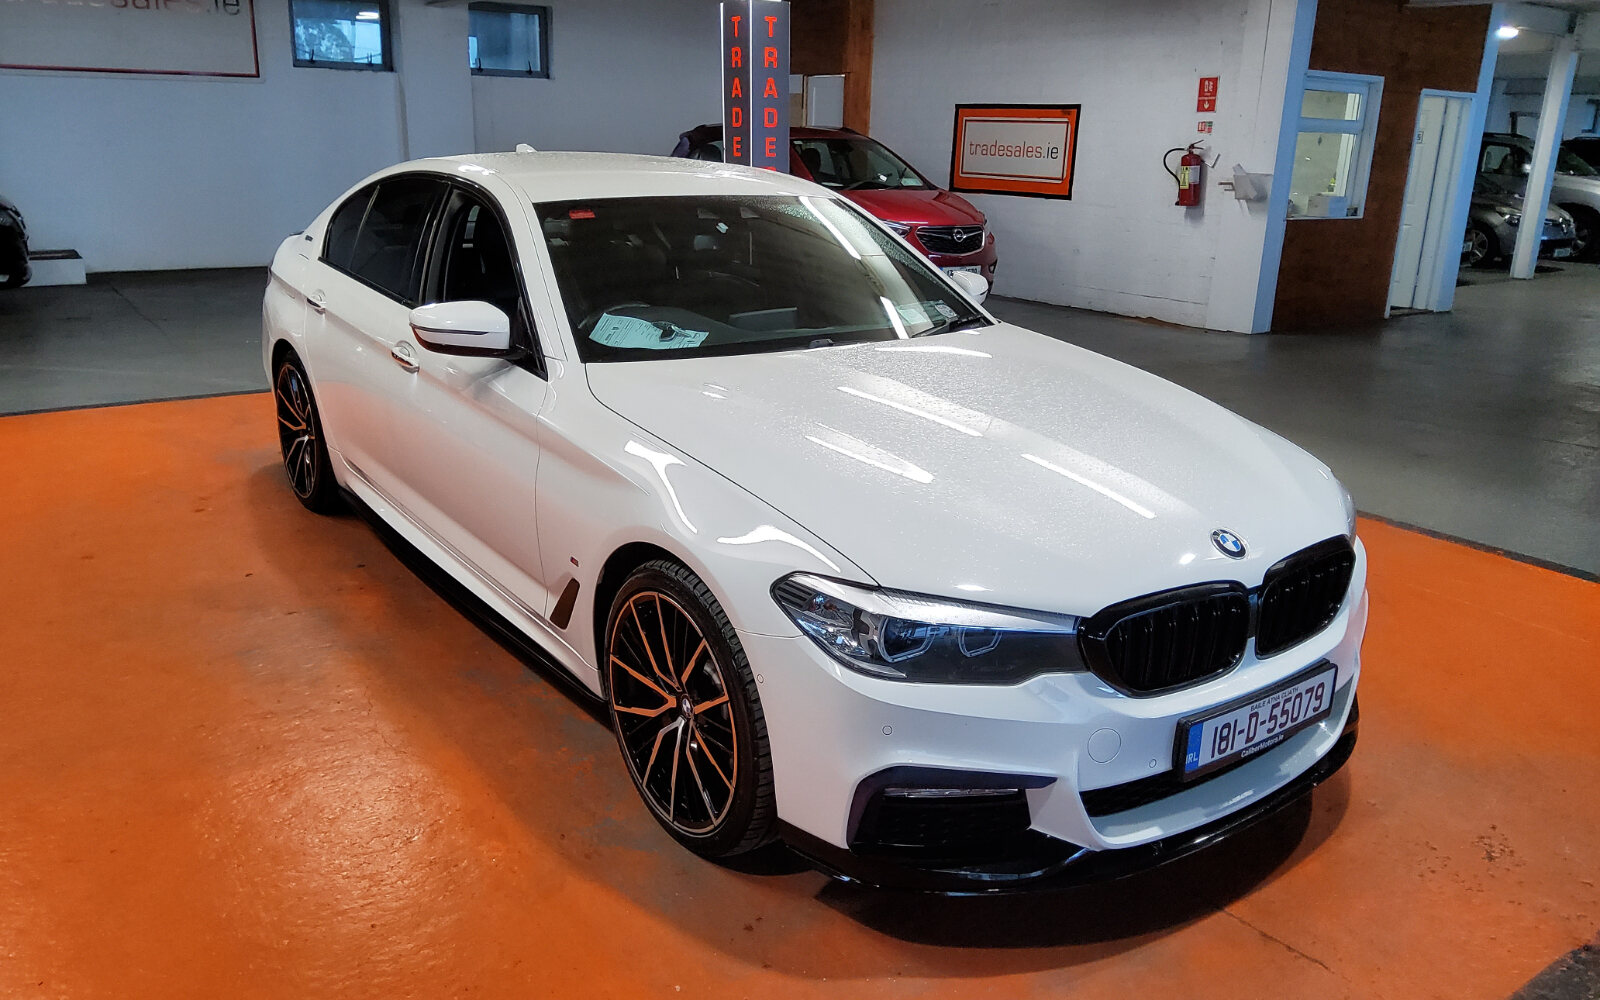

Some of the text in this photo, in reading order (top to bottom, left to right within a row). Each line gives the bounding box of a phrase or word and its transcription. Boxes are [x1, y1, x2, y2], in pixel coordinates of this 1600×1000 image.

[731, 16, 742, 157] TRADE
[763, 16, 778, 172] TRADE
[969, 140, 1059, 160] tradesales.ie
[1186, 752, 1199, 764] IRL
[1211, 682, 1325, 758] 181-D-55079
